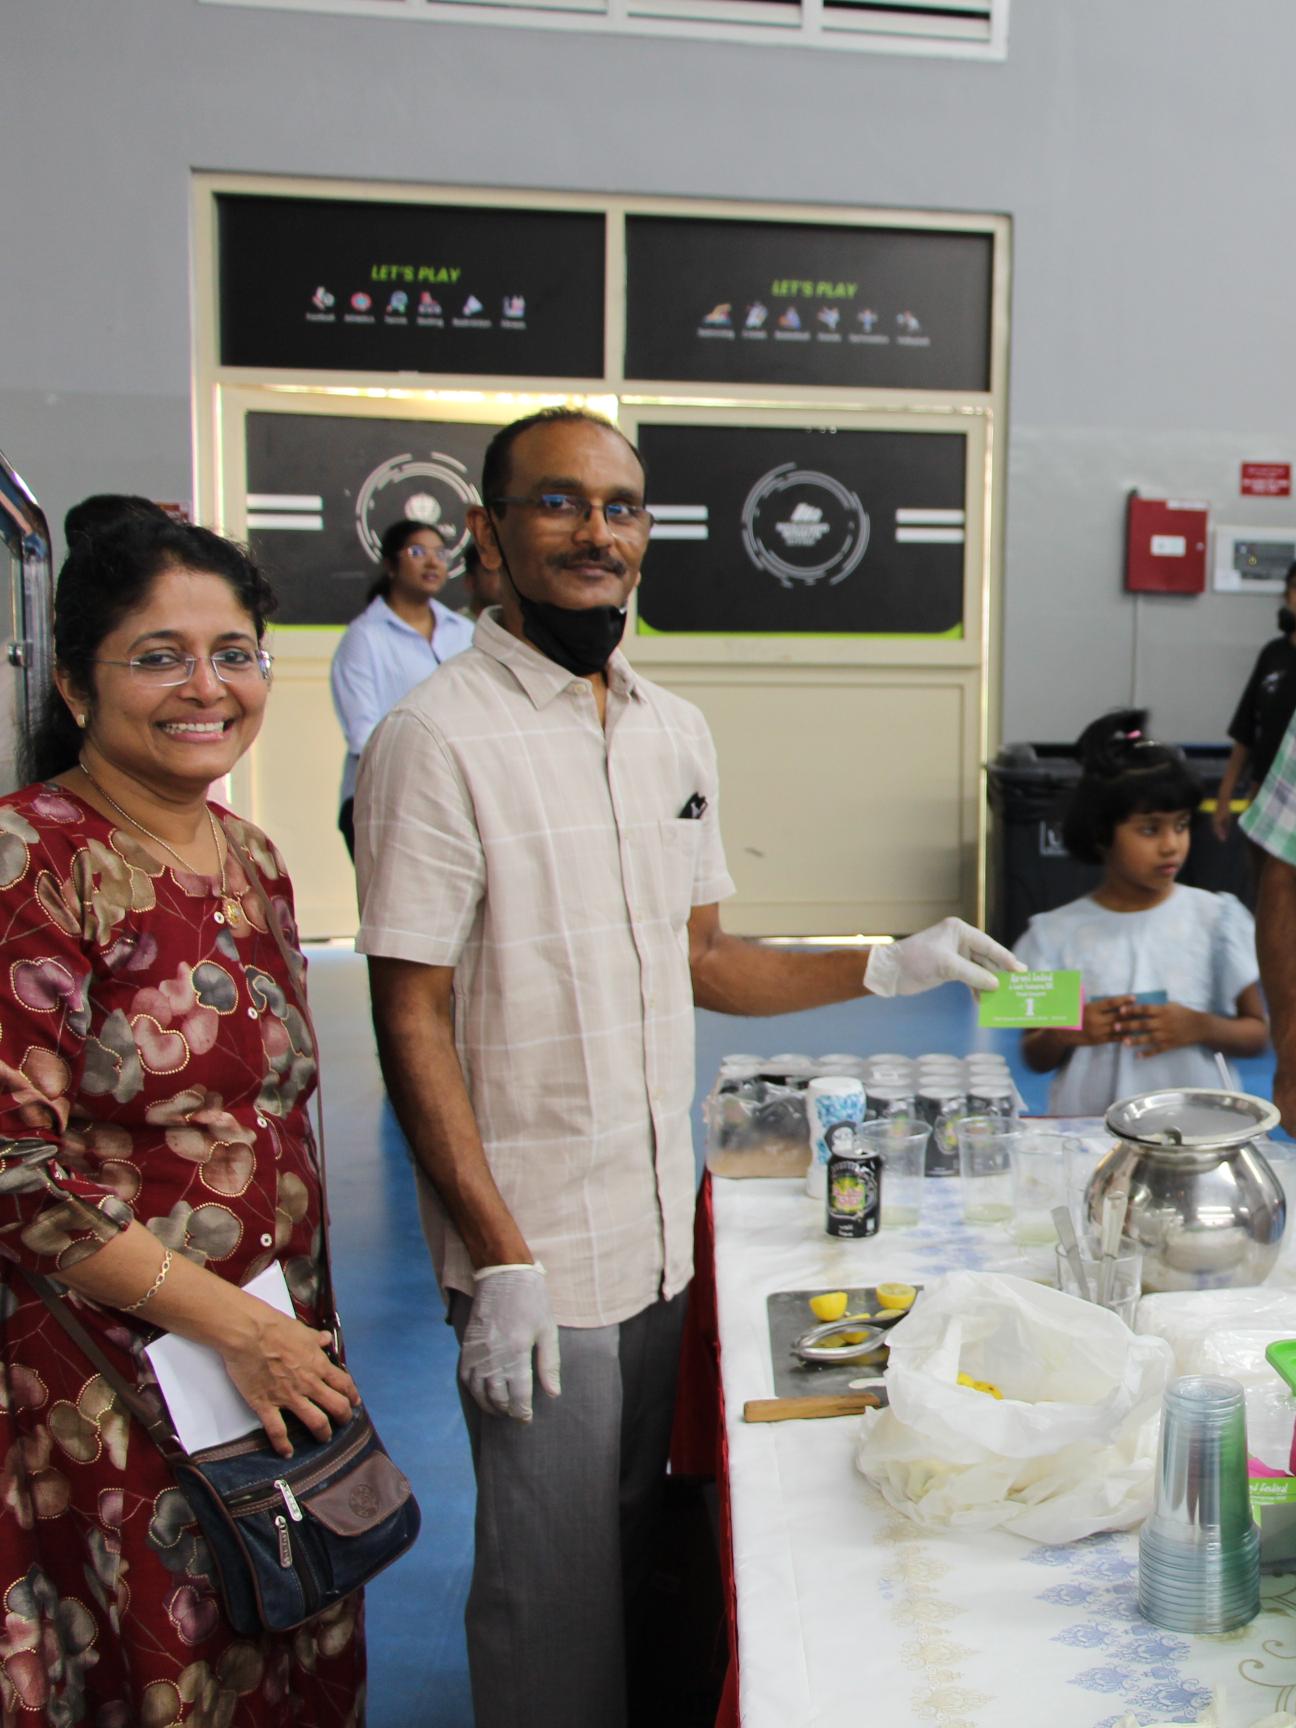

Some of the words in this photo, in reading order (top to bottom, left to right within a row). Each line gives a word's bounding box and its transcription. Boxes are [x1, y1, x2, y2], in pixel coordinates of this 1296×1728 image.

[371, 264, 415, 282] LET'S
[417, 266, 461, 284] PLAY
[771, 279, 815, 298] LET'S
[816, 281, 859, 299] PLAY
